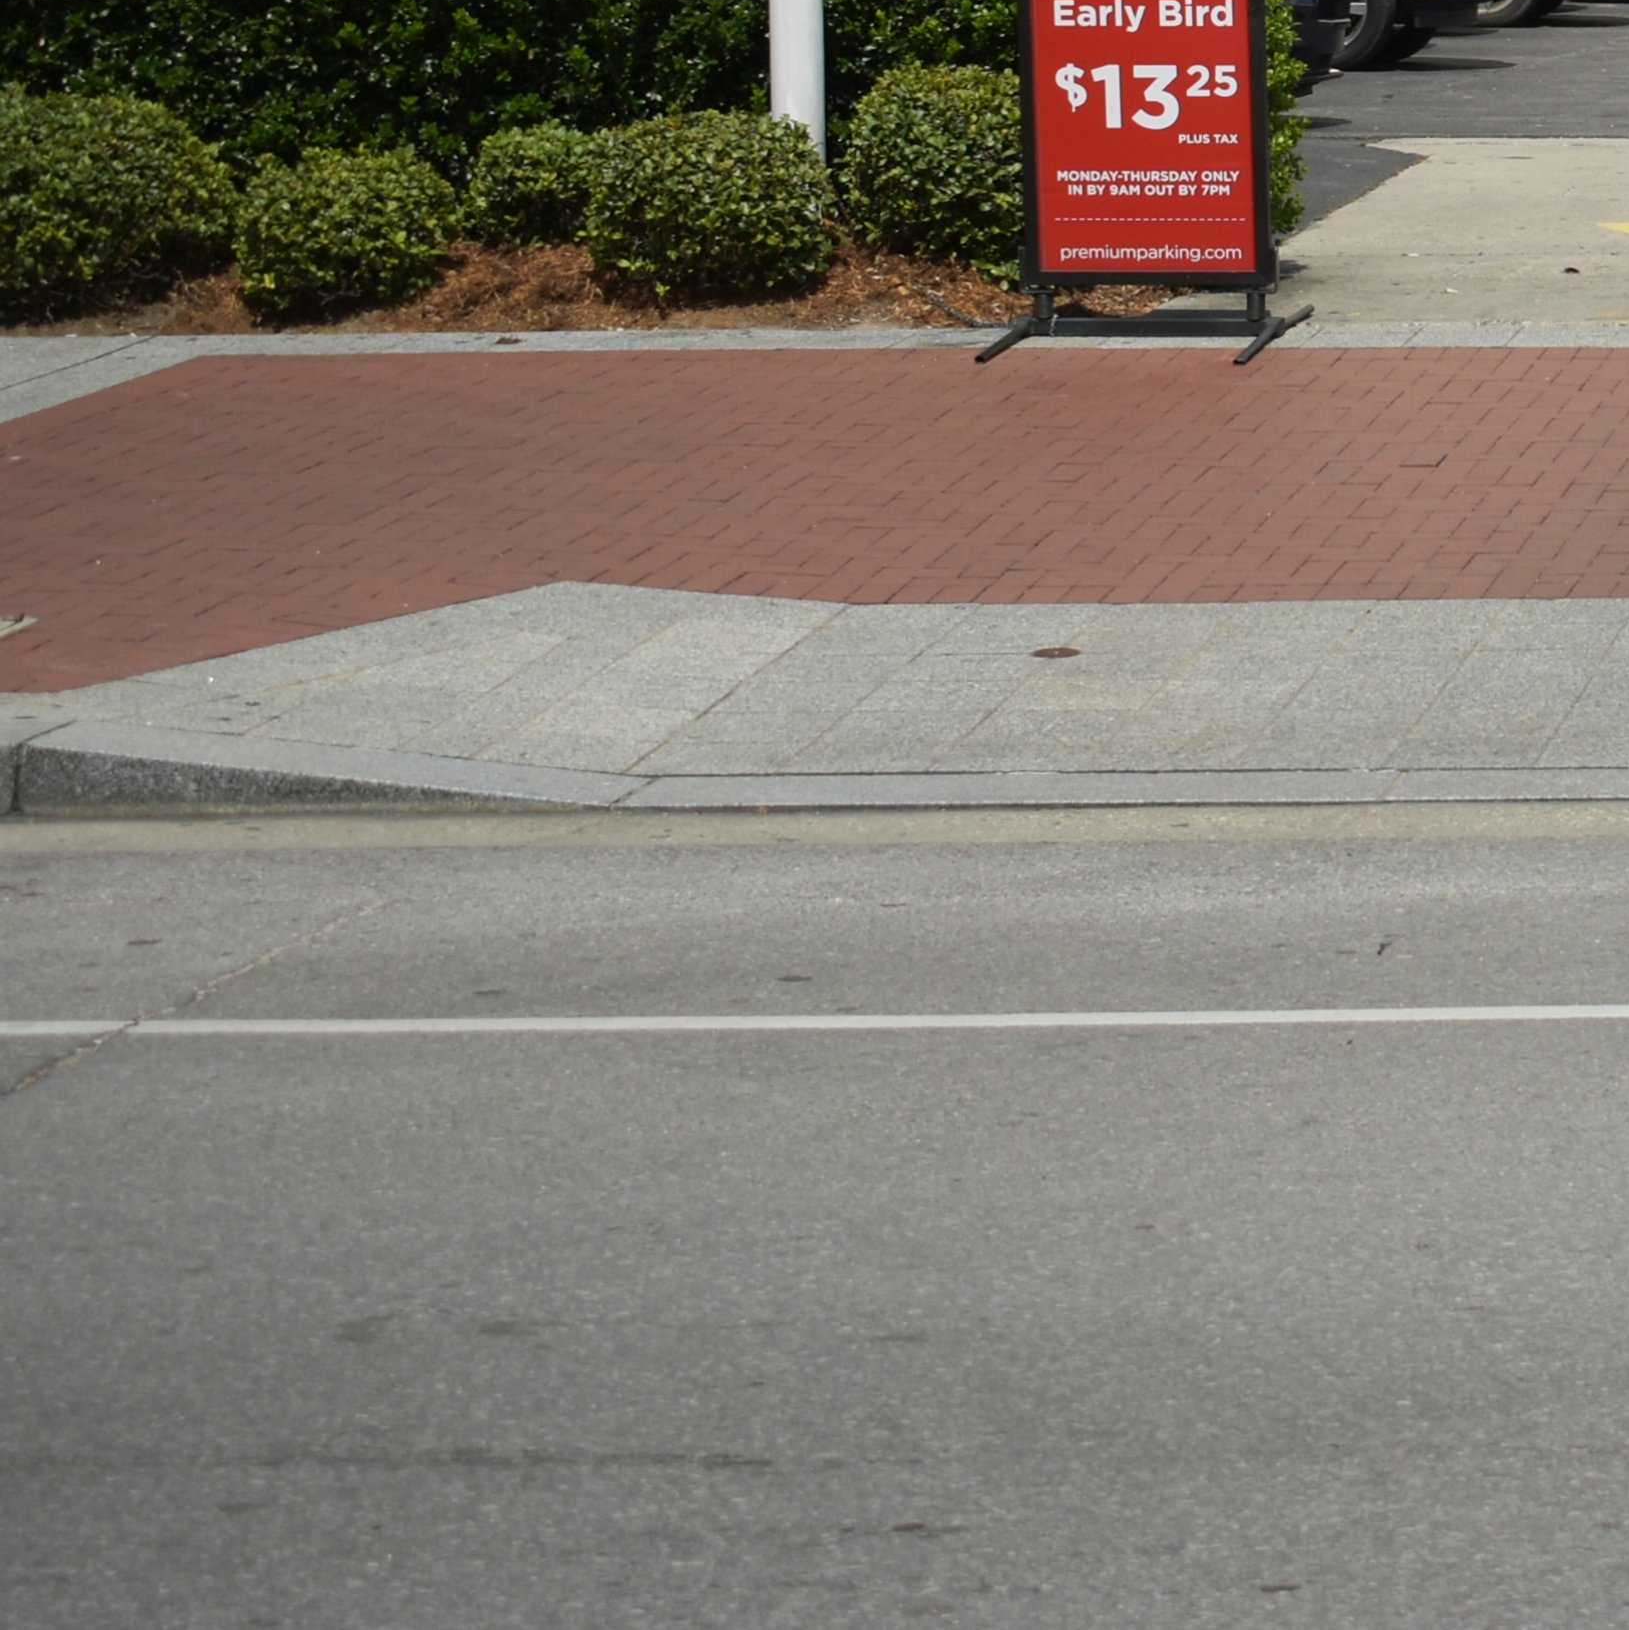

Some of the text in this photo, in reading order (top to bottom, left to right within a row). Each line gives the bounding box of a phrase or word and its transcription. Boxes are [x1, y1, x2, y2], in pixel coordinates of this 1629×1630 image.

[1178, 134, 1238, 144] PLUS TAX
[1056, 170, 1240, 182] MONDAY-THURSDAY ONLY
[1068, 185, 1230, 196] IN BY 9AM OUT BY 7PM
[1059, 244, 1242, 263] premiumparking.com
